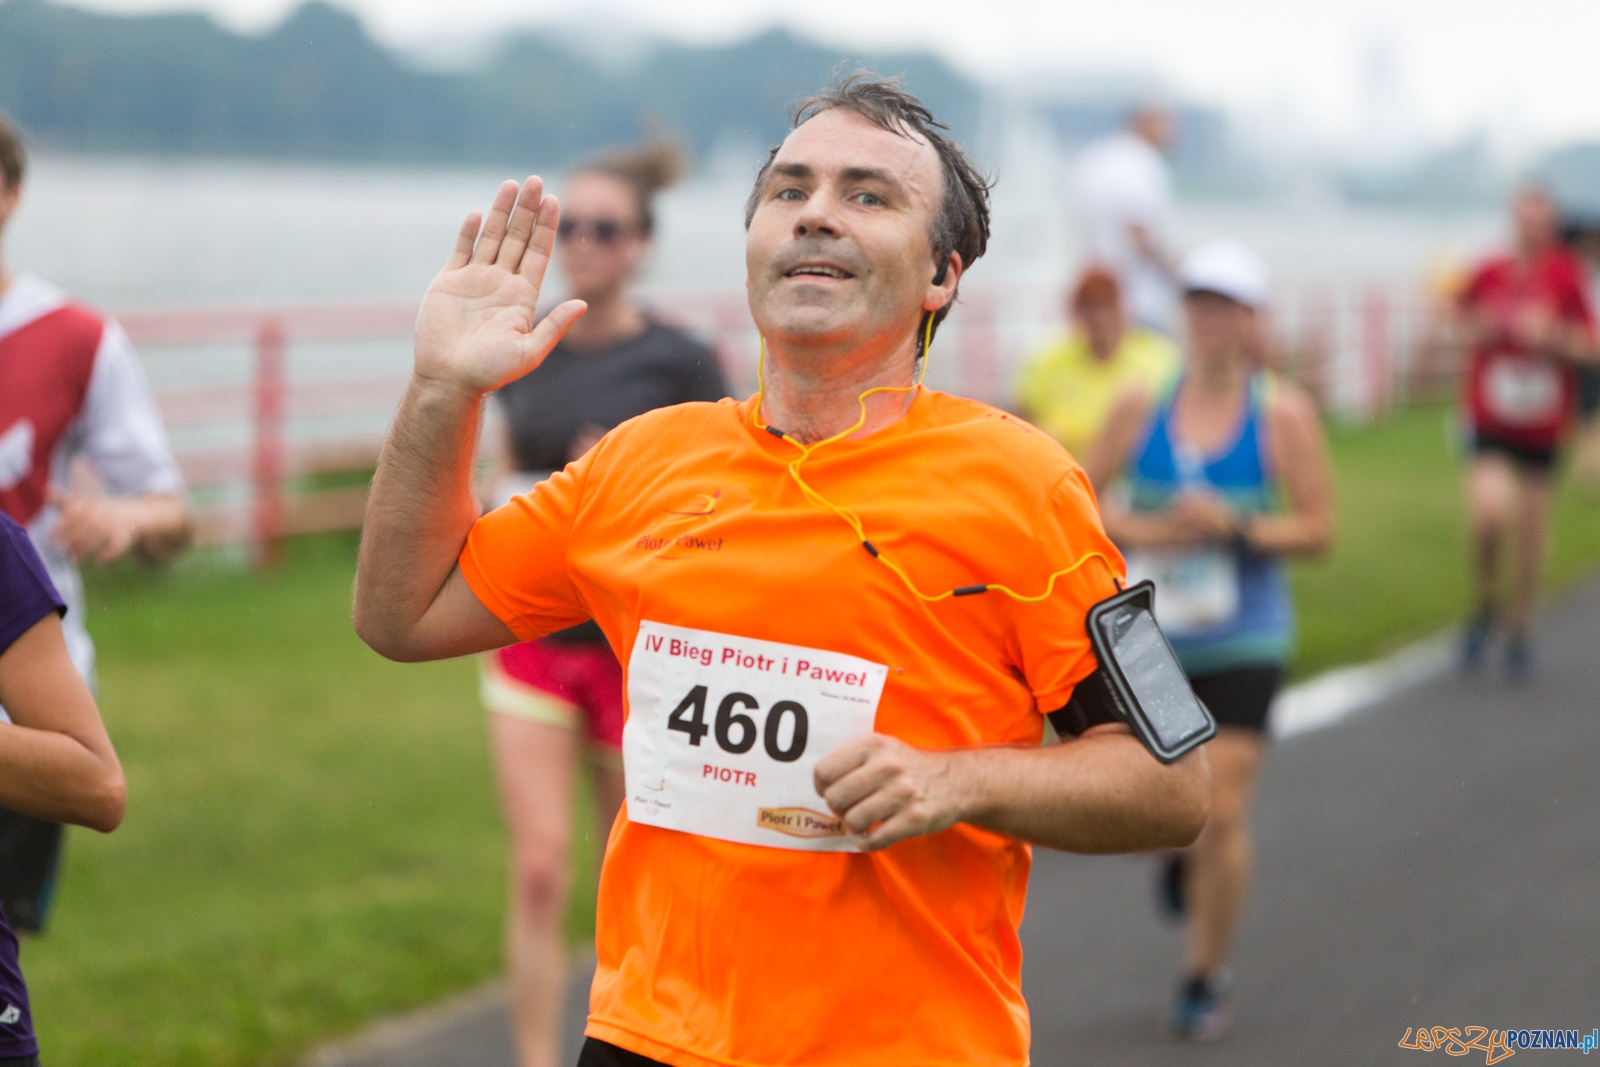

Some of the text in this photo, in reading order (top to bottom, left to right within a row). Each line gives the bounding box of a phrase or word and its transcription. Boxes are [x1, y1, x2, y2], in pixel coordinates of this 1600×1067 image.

[645, 634, 867, 687] IV Bieg Piotr i Paweł
[667, 684, 809, 762] 460
[702, 764, 757, 787] PIOTR
[761, 811, 792, 825] Piotr
